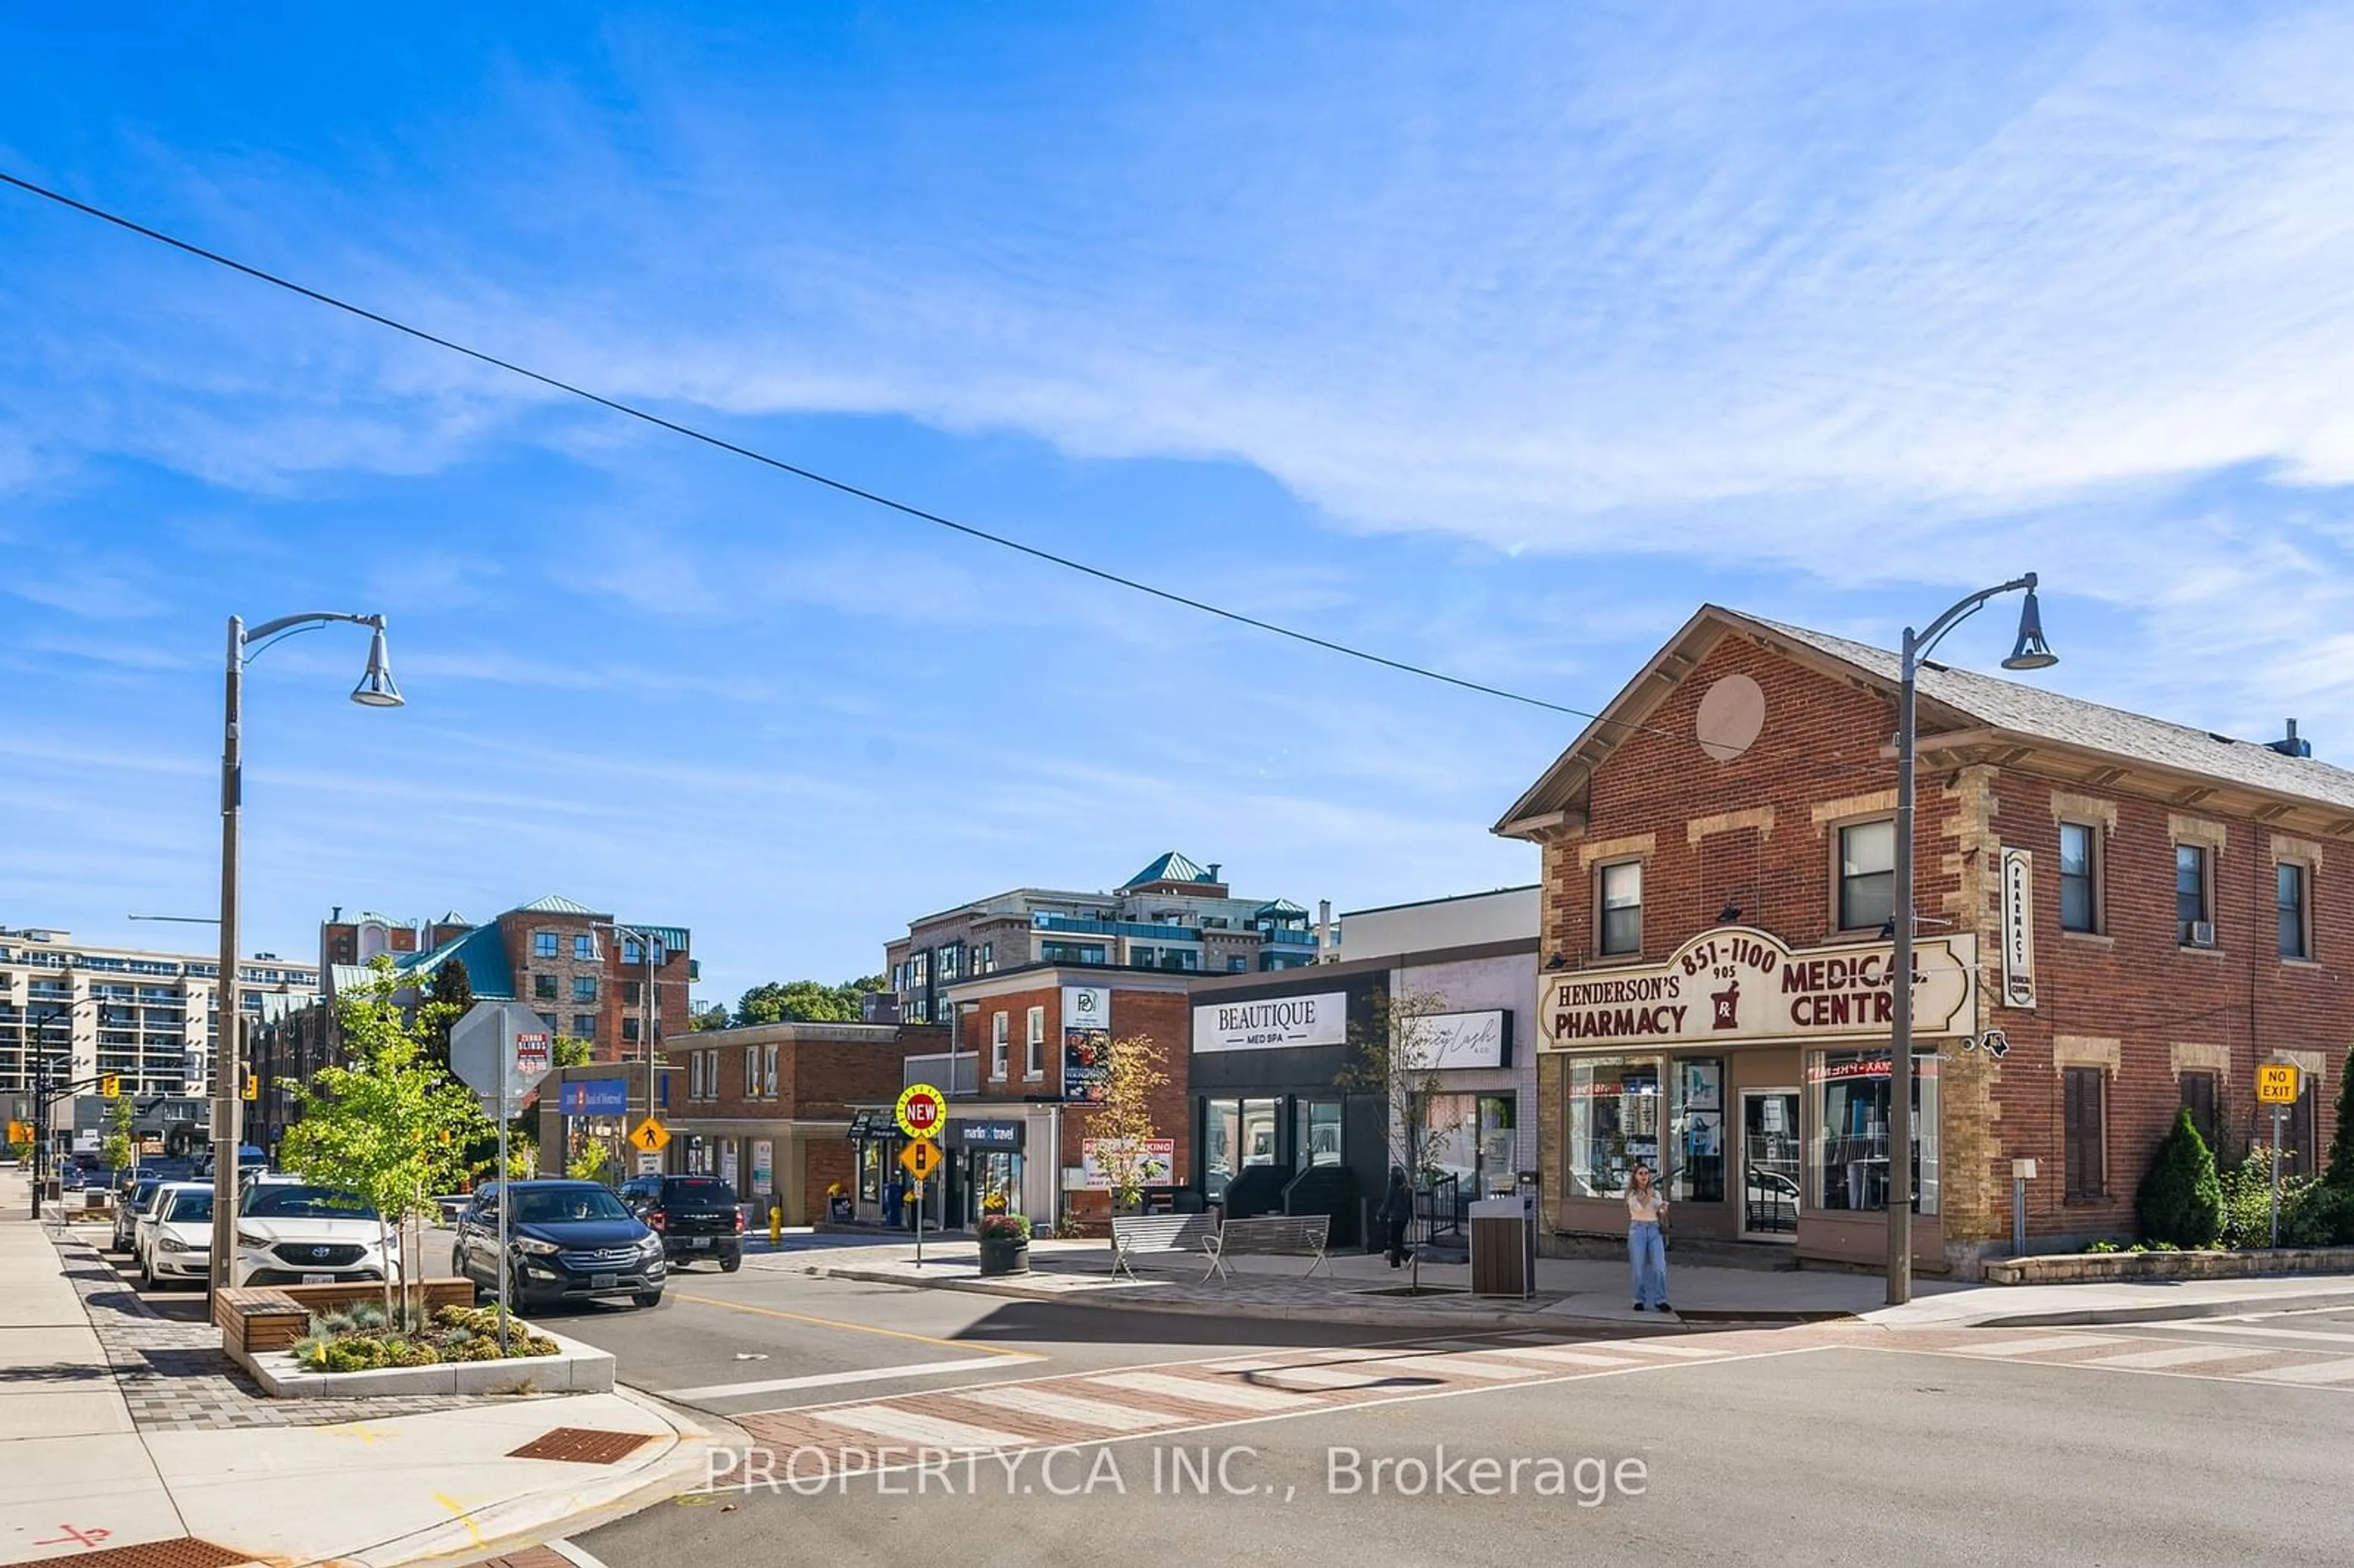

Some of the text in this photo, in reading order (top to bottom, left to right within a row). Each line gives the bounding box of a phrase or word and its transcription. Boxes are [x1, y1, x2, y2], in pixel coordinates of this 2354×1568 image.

[2014, 867, 2022, 963] PHARMACY
[1682, 937, 1777, 976] 851-1100
[1713, 965, 1735, 980] 905
[1558, 975, 1680, 1007] HENDERSON'S
[1219, 1000, 1316, 1030] BEAUTIQUE
[1555, 1005, 1688, 1040] PHARMACY
[1791, 991, 1914, 1026] CENTR
[1247, 1033, 1283, 1044] MED SPA
[2263, 1085, 2291, 1097] EXIT
[2269, 1071, 2287, 1083] NO
[907, 1103, 935, 1121] NEW
